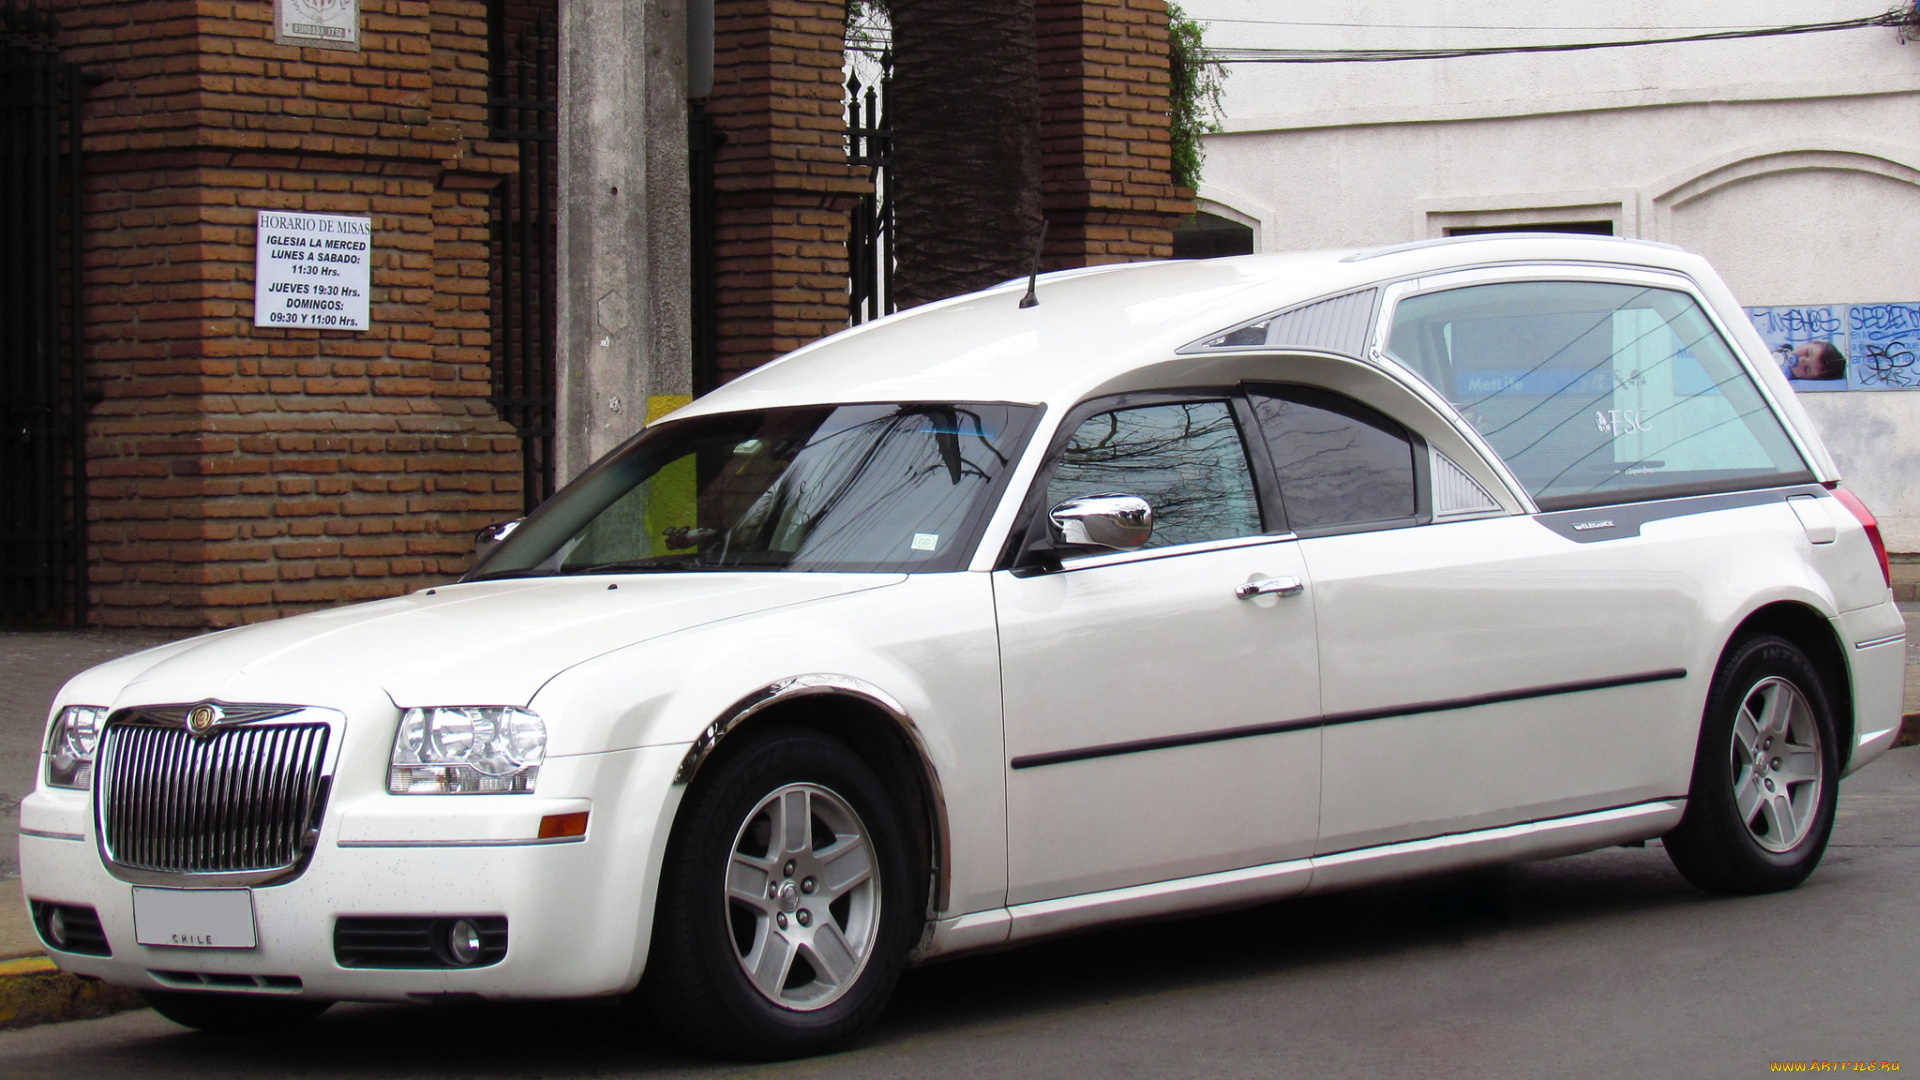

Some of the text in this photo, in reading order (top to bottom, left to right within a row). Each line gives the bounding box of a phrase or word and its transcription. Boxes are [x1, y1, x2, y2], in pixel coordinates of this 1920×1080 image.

[260, 216, 370, 235] HORARIO DE MISAS
[267, 236, 366, 250] IGLESIA LA MERCED
[271, 250, 360, 264] LUNES A SABADO:
[292, 265, 340, 276] 11:30 Hrs.
[269, 283, 360, 297] JUEVES 19:30 Hrs.
[286, 299, 343, 310] DOMINGOS:
[270, 313, 357, 326] 09:30 Y 11:00 Hrs.
[1468, 376, 1524, 392] MetLife
[172, 934, 212, 945] CHILE
